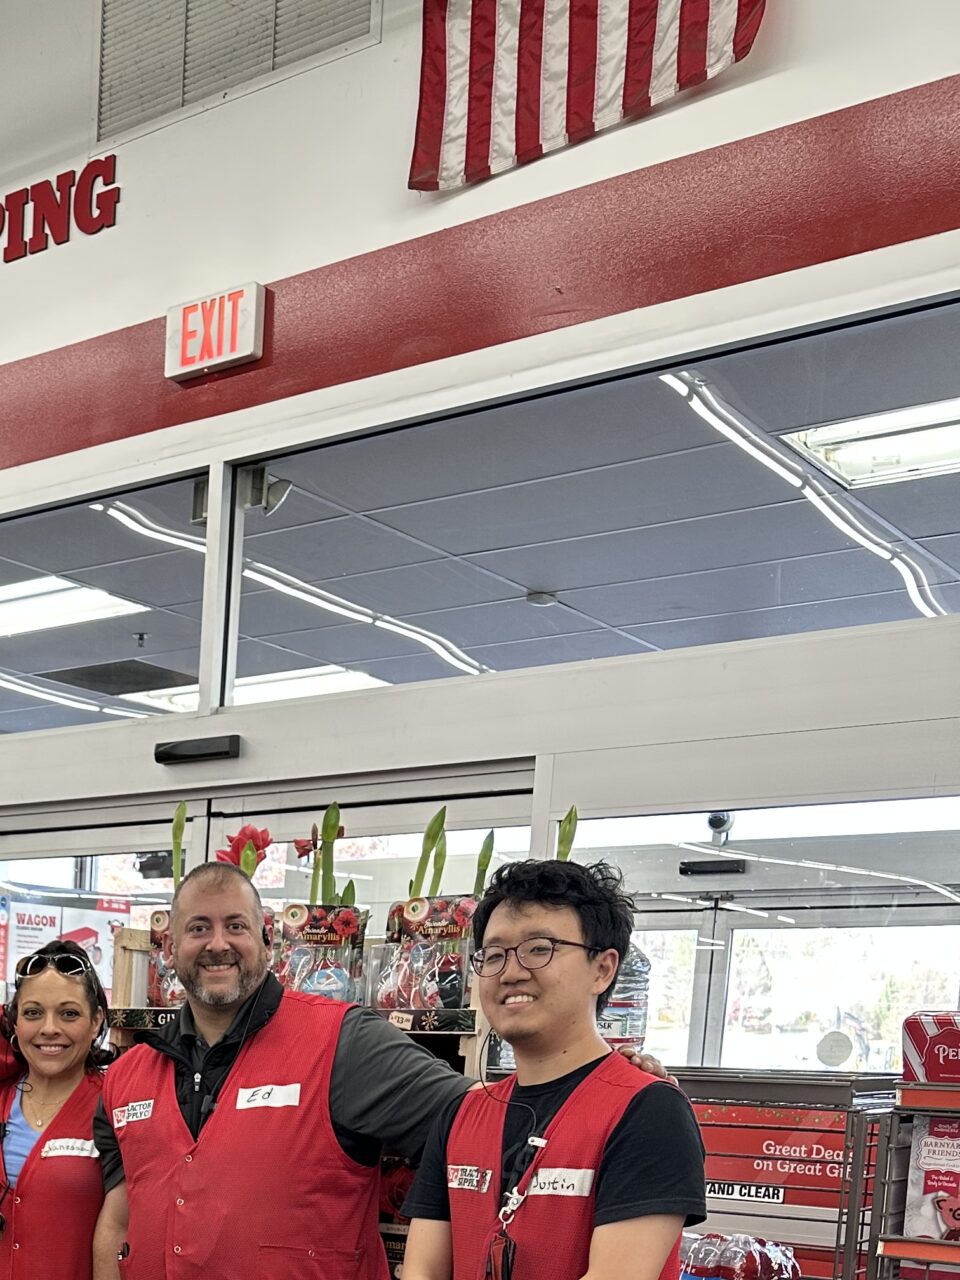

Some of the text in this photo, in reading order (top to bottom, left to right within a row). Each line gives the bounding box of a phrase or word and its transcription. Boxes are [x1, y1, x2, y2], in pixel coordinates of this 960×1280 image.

[180, 289, 244, 368] EXIT
[16, 913, 57, 928] WAGON
[934, 1044, 960, 1065] PE
[246, 1088, 274, 1103] Ed
[762, 1140, 807, 1158] Great
[753, 1159, 773, 1171] on
[777, 1160, 823, 1176] Great
[708, 1183, 781, 1200] AND CLEAR
